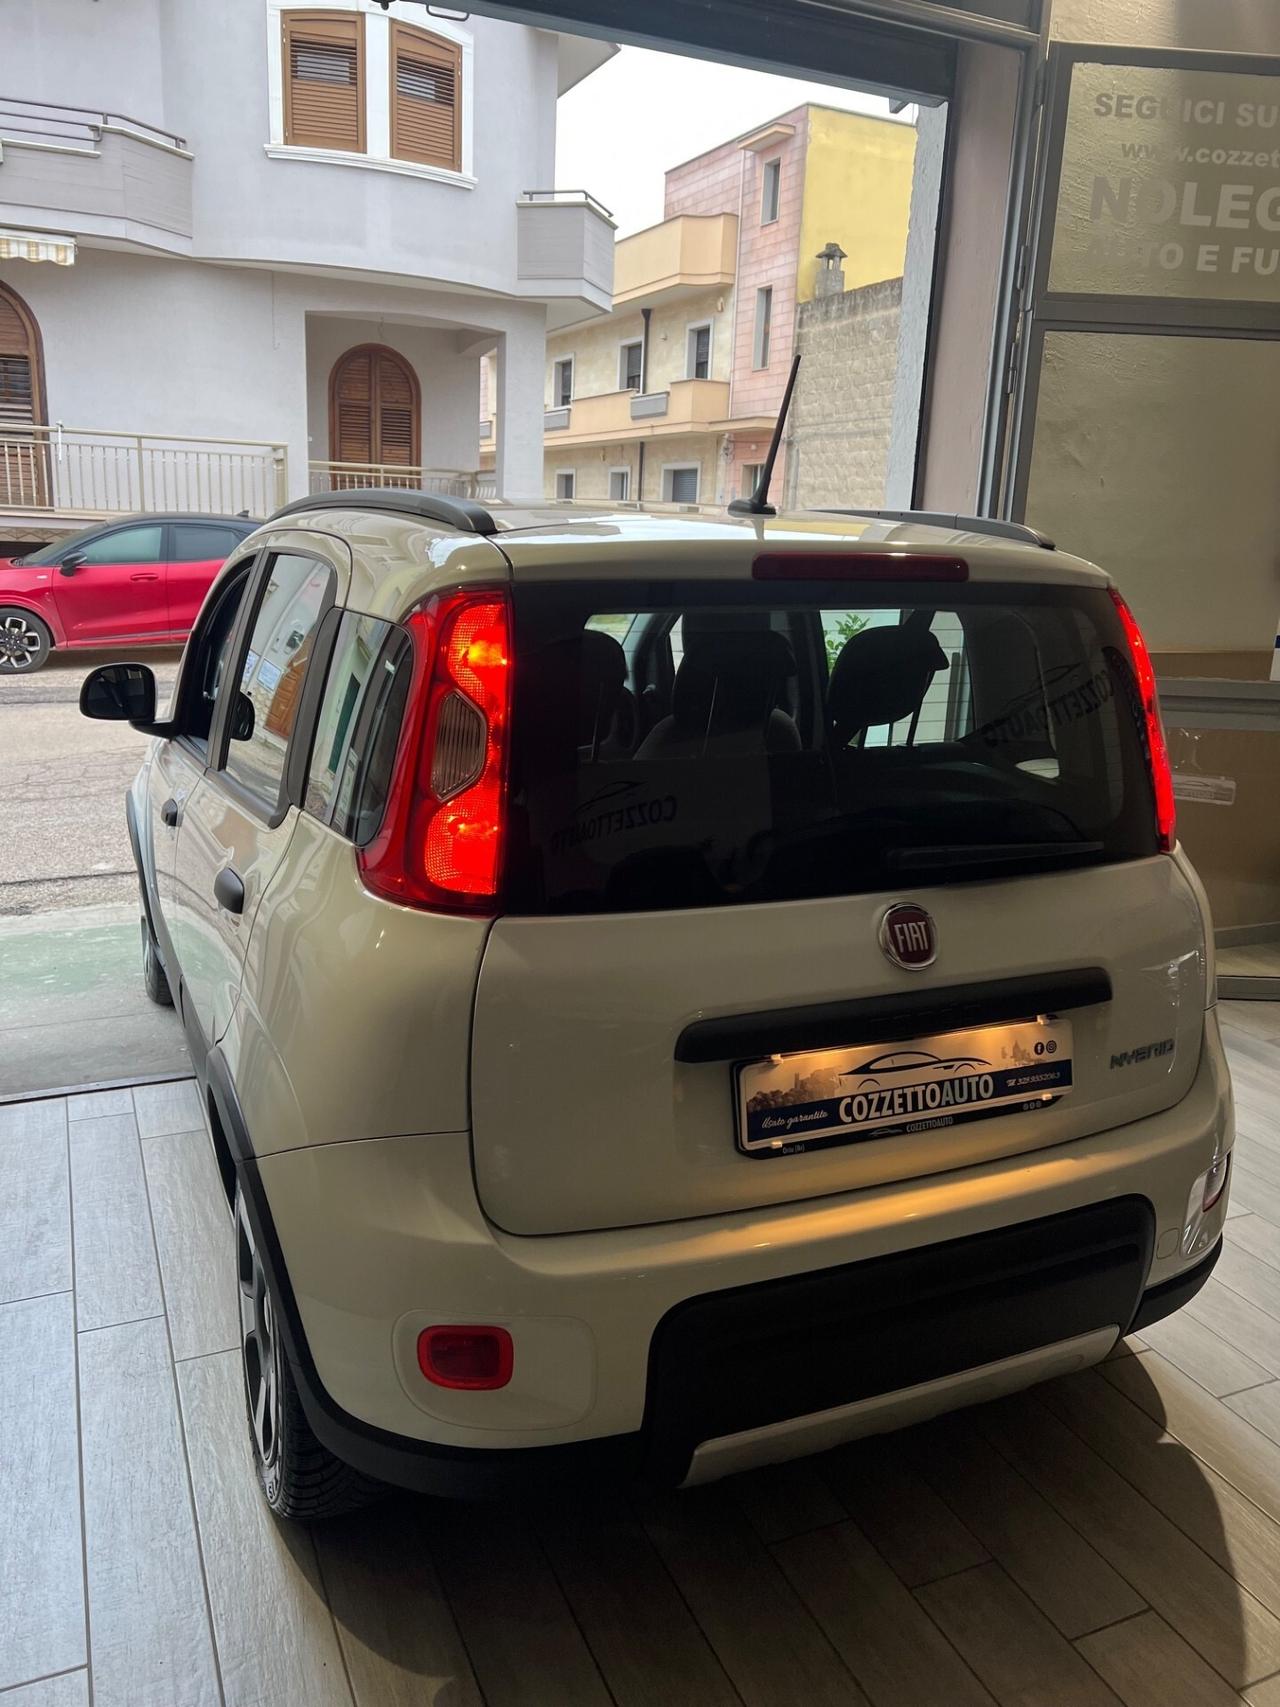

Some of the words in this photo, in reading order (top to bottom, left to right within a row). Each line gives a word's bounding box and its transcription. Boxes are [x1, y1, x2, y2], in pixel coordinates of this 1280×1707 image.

[1235, 101, 1280, 128] SU
[1088, 238, 1184, 270] TO
[1196, 244, 1221, 272] E
[893, 921, 929, 953] FIAT
[1109, 1038, 1175, 1070] HYBRID
[839, 1074, 995, 1123] COZZETTOAUTO
[786, 1109, 829, 1130] garantito
[906, 1116, 953, 1133] COZZETTOAUTO
